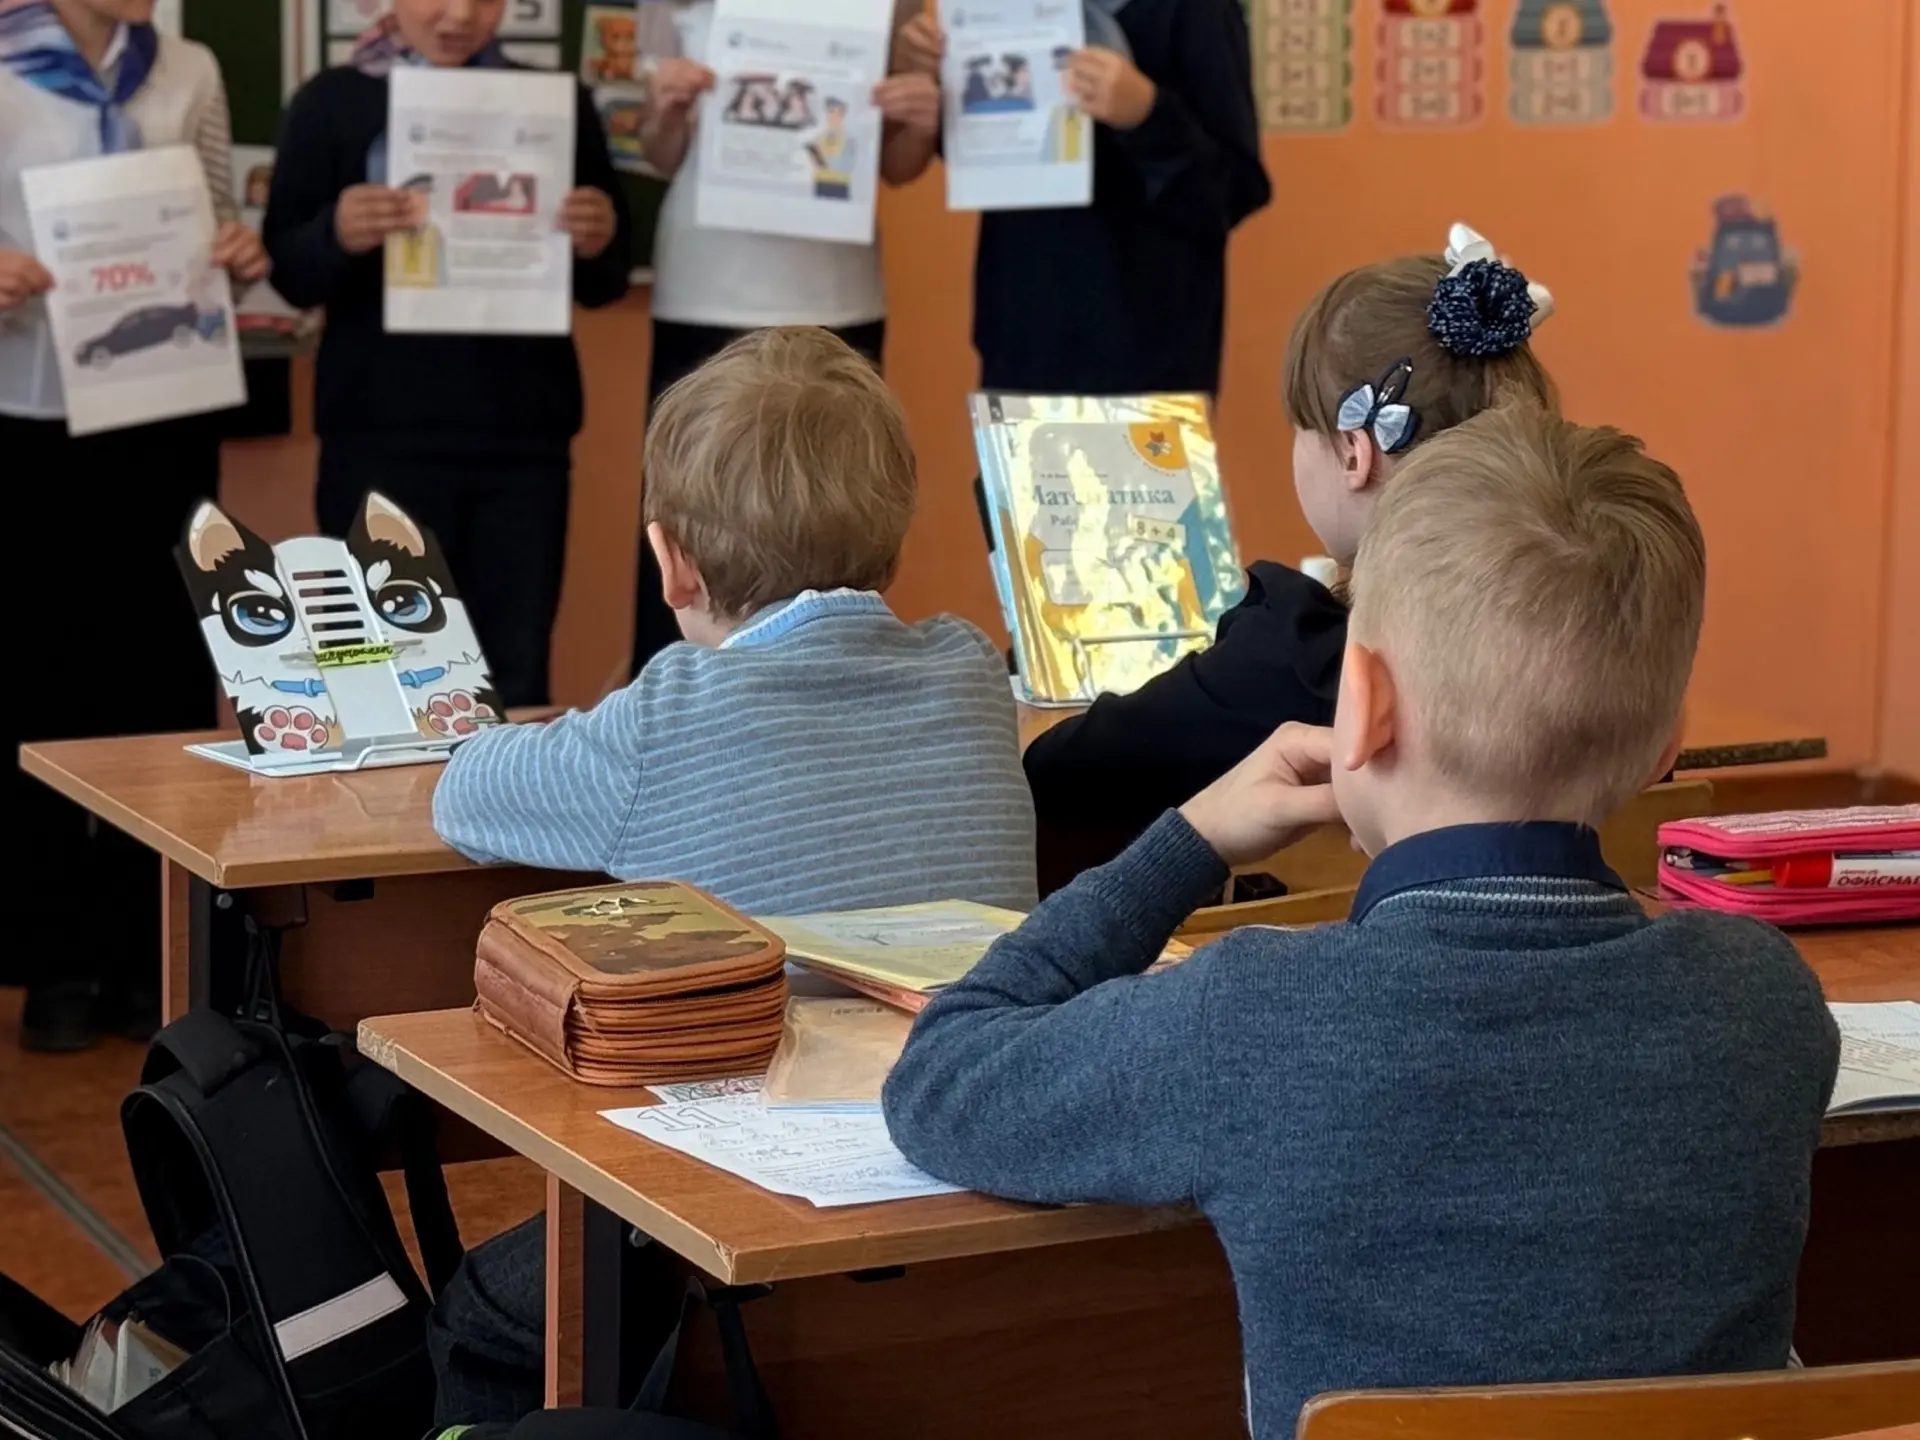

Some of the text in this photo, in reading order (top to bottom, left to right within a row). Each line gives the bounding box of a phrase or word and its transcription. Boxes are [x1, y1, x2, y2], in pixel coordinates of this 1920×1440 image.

[90, 261, 155, 293] 70%
[1032, 484, 1176, 506] ататика
[1136, 520, 1146, 536] 8
[1165, 526, 1176, 539] 4
